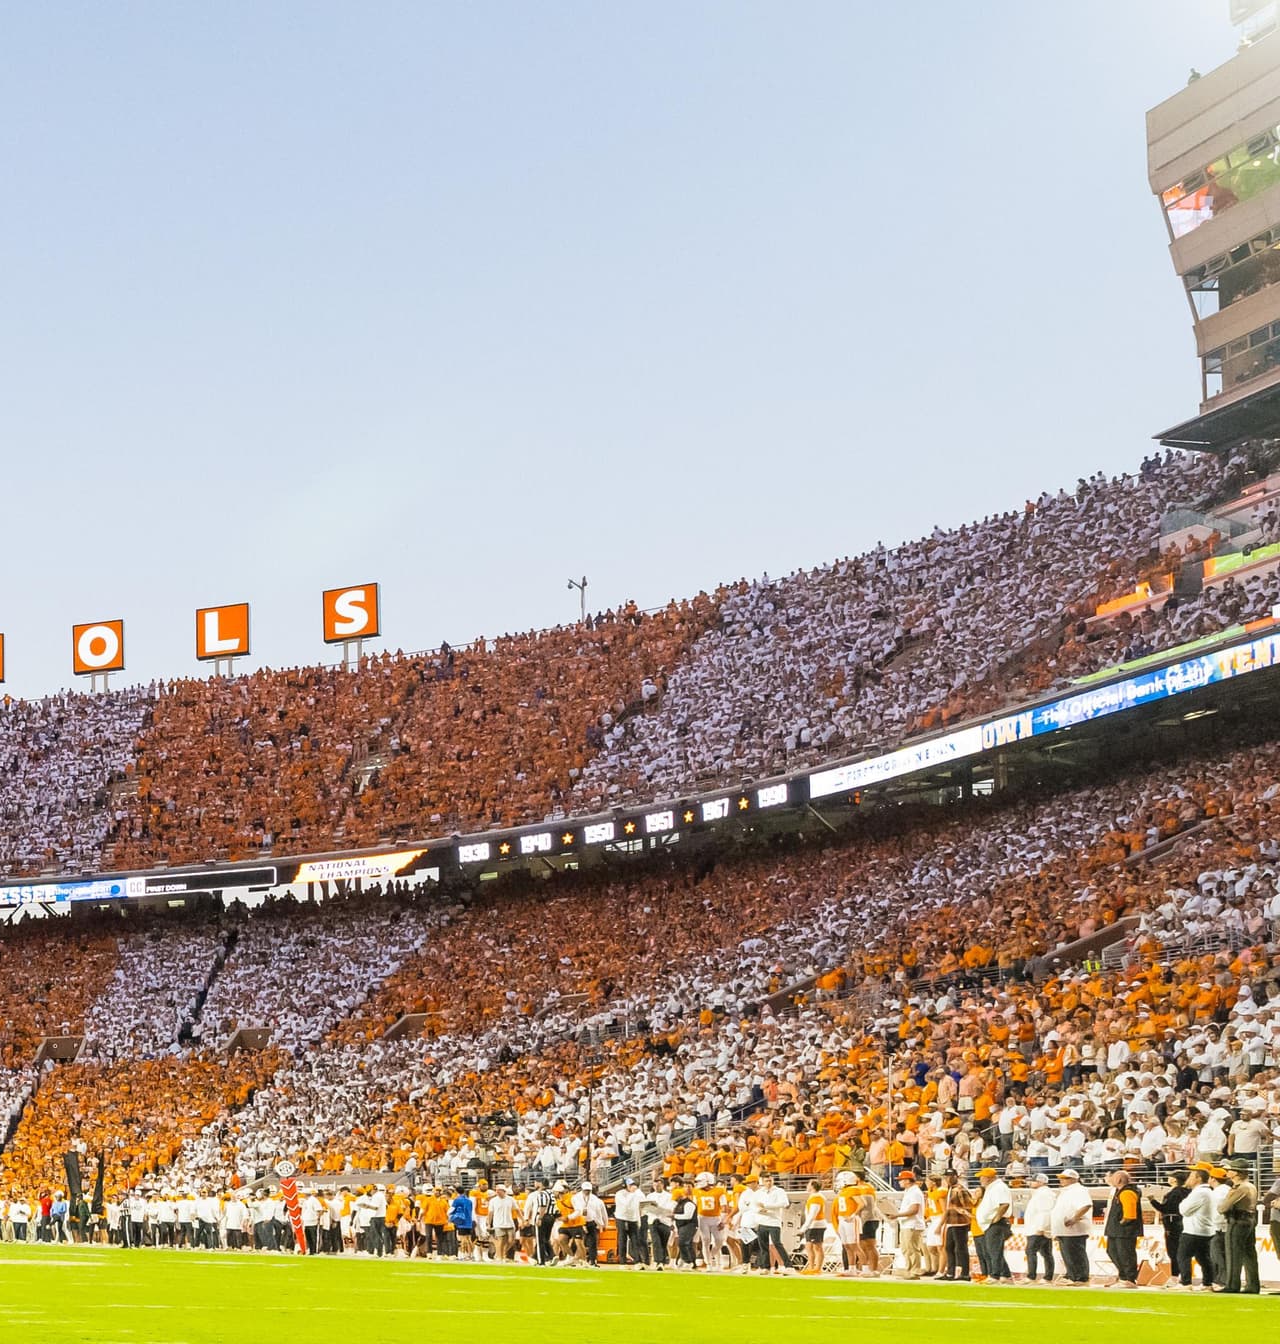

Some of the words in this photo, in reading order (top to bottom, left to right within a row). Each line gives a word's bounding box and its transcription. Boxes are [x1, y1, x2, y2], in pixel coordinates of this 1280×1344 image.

[77, 625, 120, 667] O
[204, 611, 241, 654] L
[333, 589, 369, 635] S
[308, 859, 368, 872] NATIONAL
[319, 866, 390, 880] CHAMPIONS
[700, 1195, 715, 1211] 13
